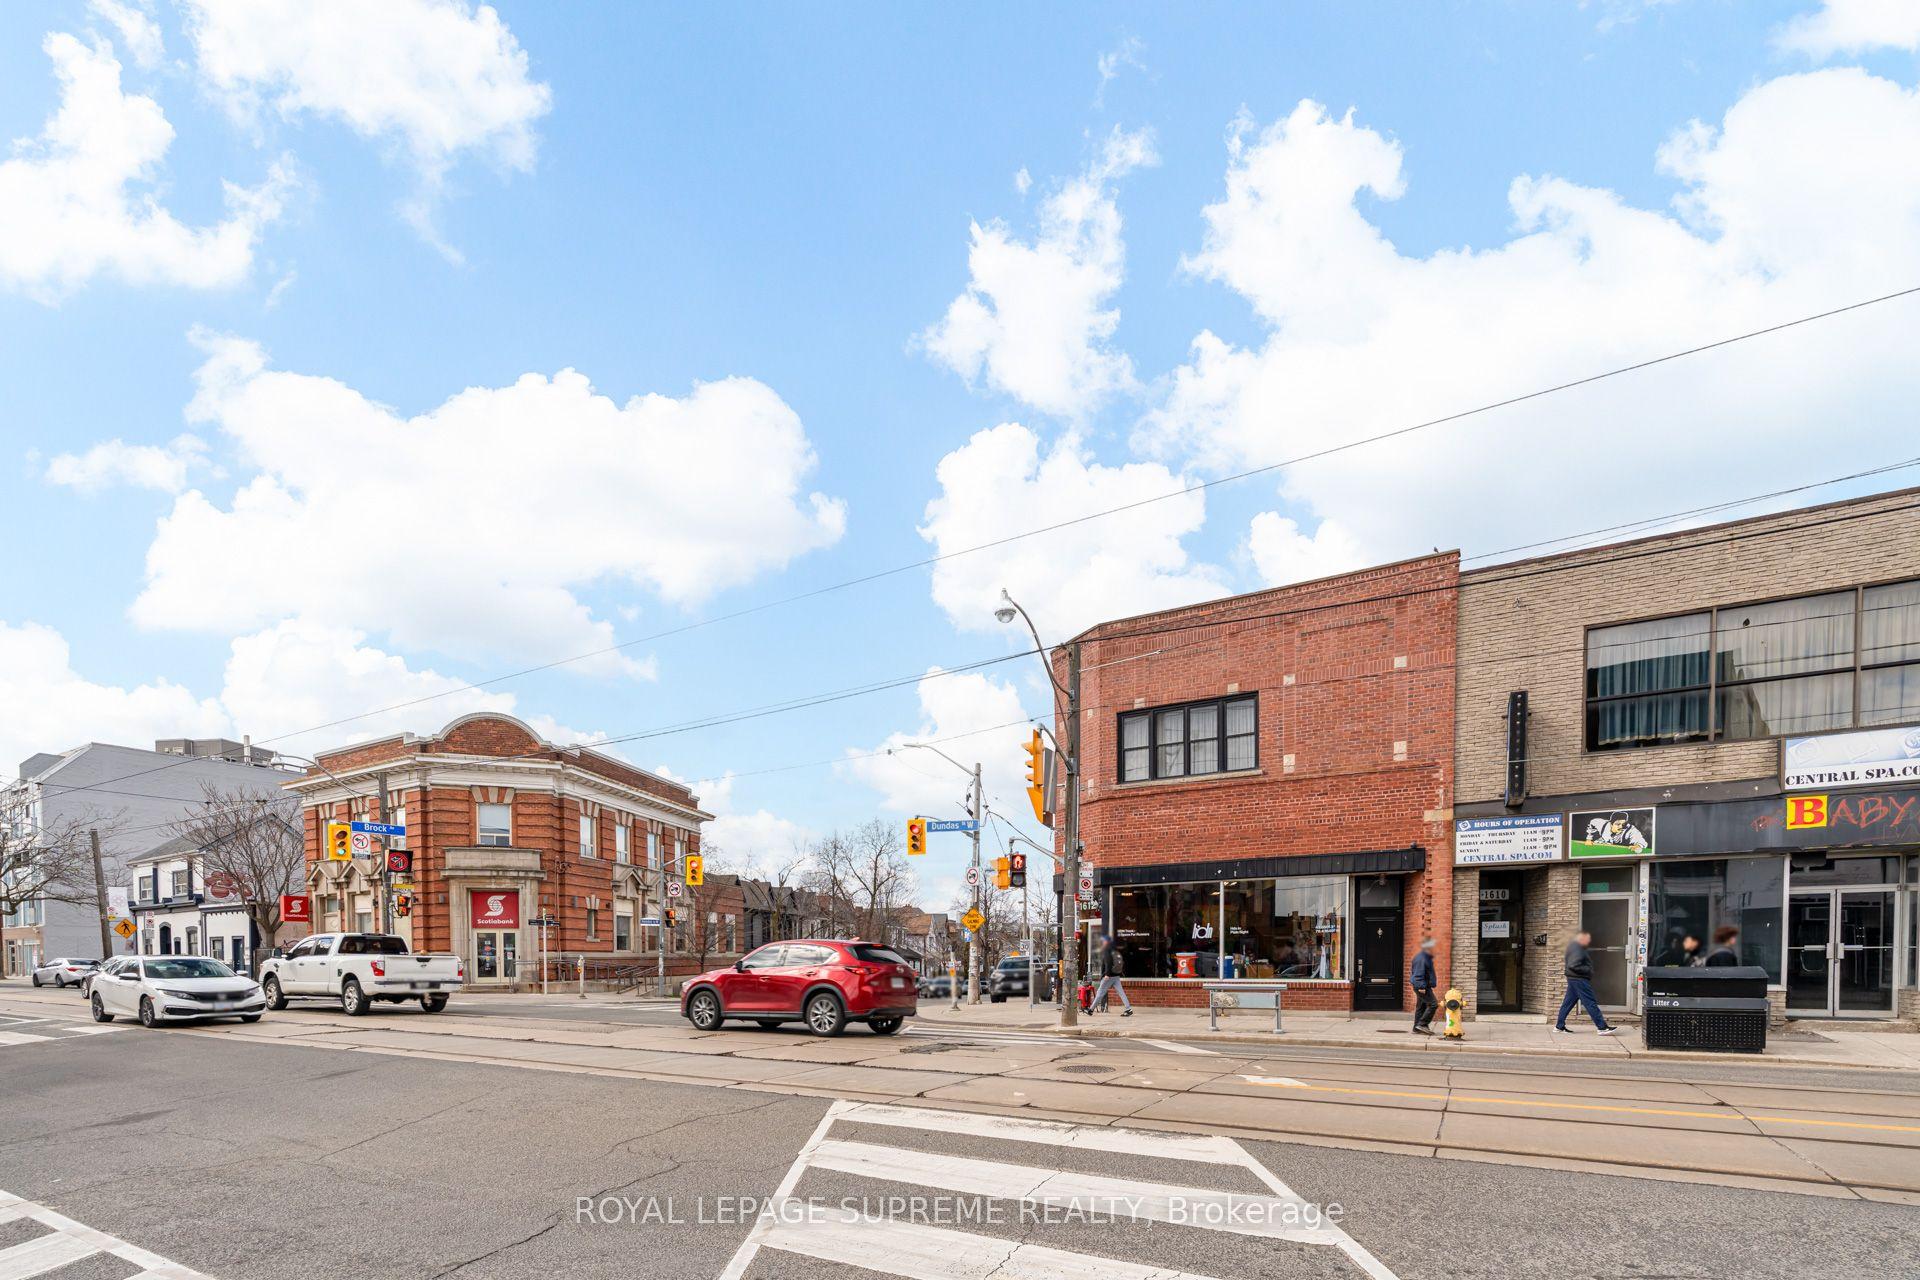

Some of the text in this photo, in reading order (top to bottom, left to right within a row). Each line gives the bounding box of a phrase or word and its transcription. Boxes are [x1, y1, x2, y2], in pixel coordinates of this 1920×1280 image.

[1785, 770, 1860, 786] CENTRAL
[364, 823, 387, 832] Brock
[931, 822, 960, 830] Dundas
[966, 820, 974, 829] W
[1474, 817, 1560, 828] HOURS OF OPERATION
[1463, 851, 1552, 862] CENTRAL SPA.COM
[1484, 890, 1506, 899] 1610
